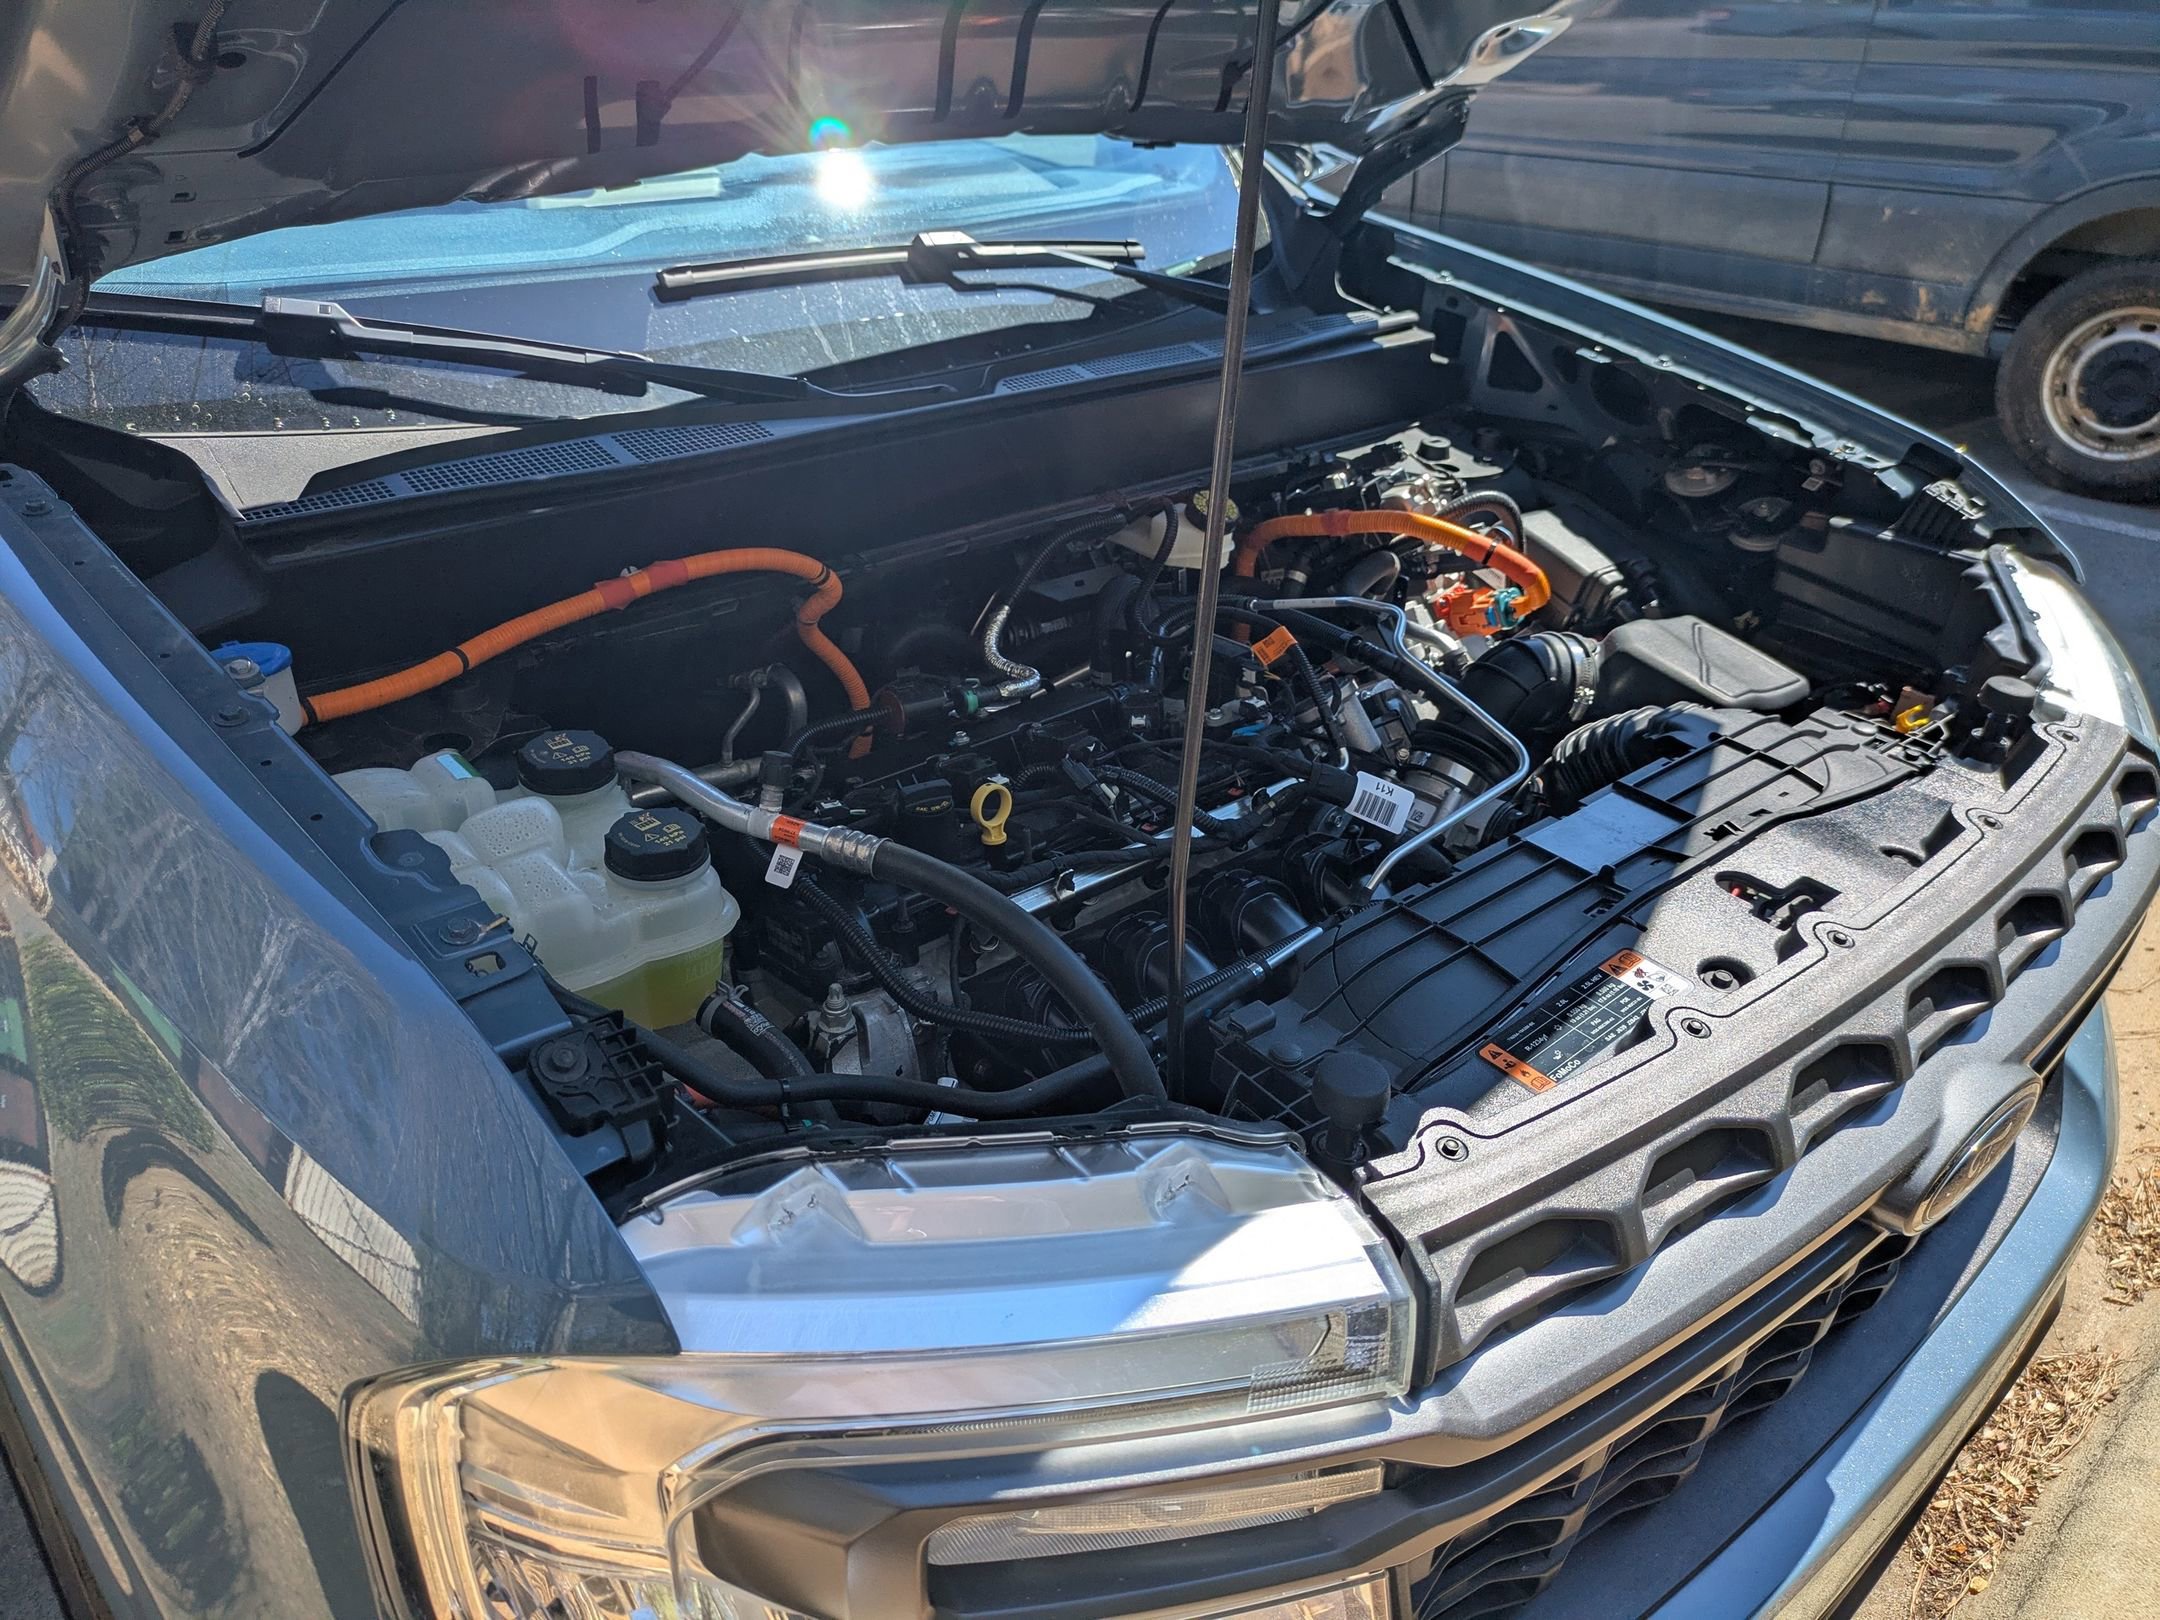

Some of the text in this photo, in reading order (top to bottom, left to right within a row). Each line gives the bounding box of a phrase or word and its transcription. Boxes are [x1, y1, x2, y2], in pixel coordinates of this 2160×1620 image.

[1375, 782, 1395, 797] K11
[1590, 974, 1602, 982] HEV
[1590, 1018, 1601, 1026] PAG
[1605, 1033, 1616, 1041] SAE
[1616, 1024, 1627, 1033] J639
[1524, 1034, 1551, 1051] R-1234yf
[1550, 1060, 1581, 1081] FoMoCo
